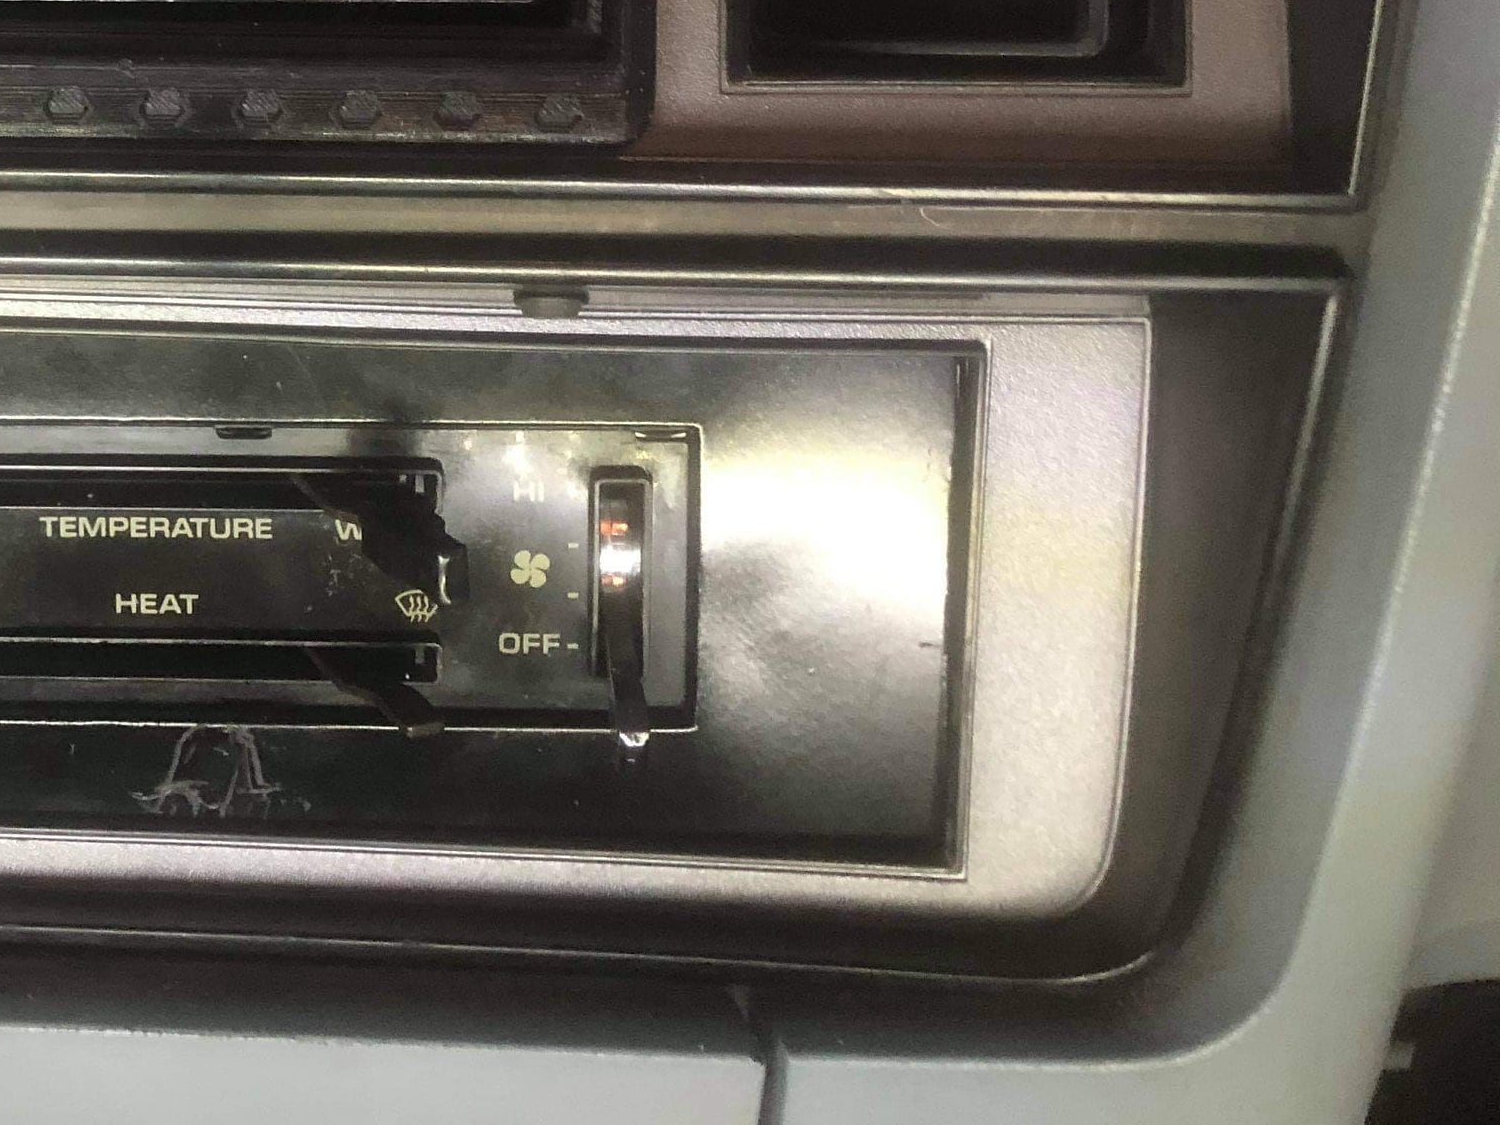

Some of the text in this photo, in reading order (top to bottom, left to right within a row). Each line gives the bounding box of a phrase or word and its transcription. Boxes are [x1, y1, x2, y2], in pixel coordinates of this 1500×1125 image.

[39, 516, 274, 540] TEMPERATURE
[114, 592, 200, 615] HEAT
[498, 632, 561, 655] OFF
